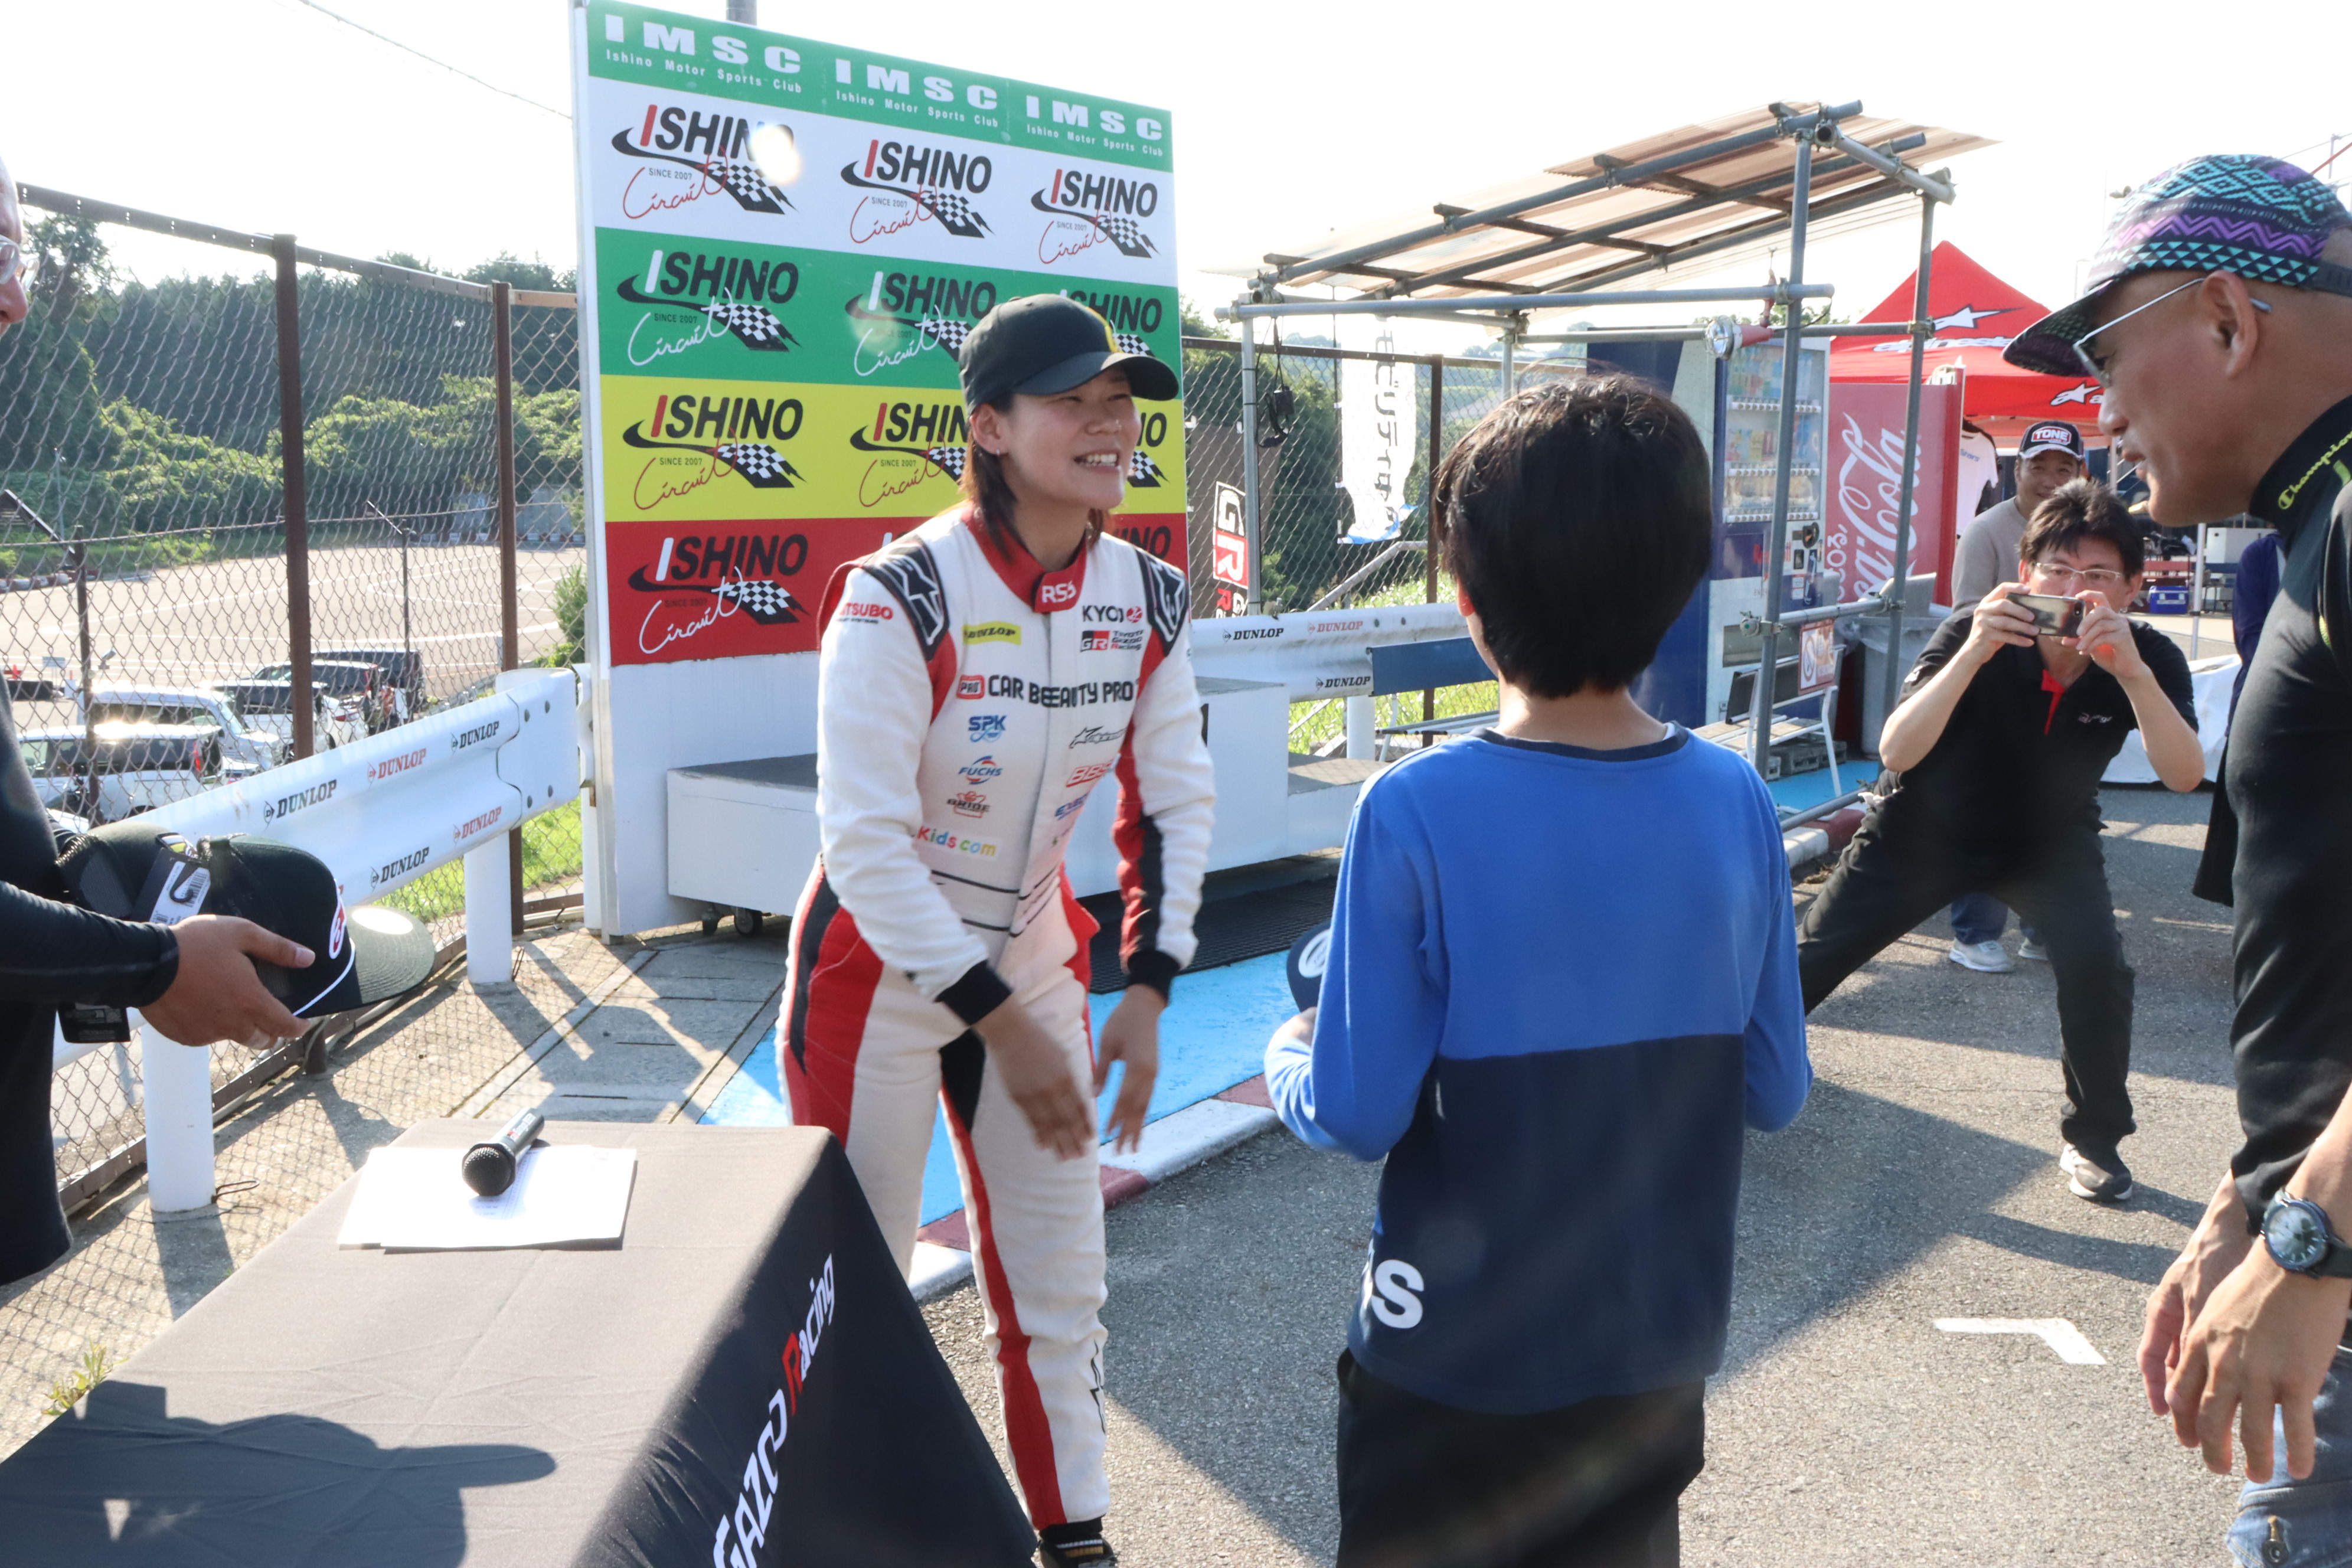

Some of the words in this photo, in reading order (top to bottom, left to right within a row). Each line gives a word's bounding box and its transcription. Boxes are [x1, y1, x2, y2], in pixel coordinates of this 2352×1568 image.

[606, 49, 652, 67] Ishino
[665, 60, 705, 76] Motor
[717, 68, 762, 86] Sports
[773, 79, 801, 93] Club
[837, 90, 874, 106] Ishino
[885, 99, 918, 113] Motor
[928, 106, 965, 122] Sports
[974, 115, 998, 128] Club
[1027, 124, 1059, 138] Ishino
[1067, 131, 1095, 145] Motor
[1103, 138, 1135, 152] Sports
[1142, 145, 1162, 156] Club
[623, 145, 728, 219] Circuit
[649, 168, 672, 178] SINCE
[675, 171, 692, 181] 2007
[864, 139, 992, 194] ISHINO
[850, 176, 937, 243] Circuit
[871, 198, 891, 207] SINCE
[893, 199, 908, 208] 2007
[1051, 169, 1158, 217] ISHINO
[1039, 201, 1112, 264] Circuit
[1056, 221, 1072, 230] SINCE
[1074, 223, 1087, 231] 2007
[645, 250, 799, 303] ISHINO
[868, 271, 997, 319] ISHINO
[628, 287, 733, 366] Circuit
[654, 313, 677, 323] SINCE
[680, 315, 698, 324] 2007
[854, 305, 943, 377] Circuit
[651, 395, 803, 440] ISHINO
[873, 403, 967, 443] ISHIN
[2036, 430, 2069, 442] TONE
[634, 427, 738, 510] Circuit
[859, 432, 946, 507] Circuit
[1217, 490, 1244, 581] GR
[655, 534, 808, 581] ISHINO
[639, 566, 743, 654] Circuit
[1317, 621, 1363, 632] DUNLOP
[968, 628, 1015, 638] DUNLOP
[1080, 634, 1110, 652] GR
[1233, 628, 1284, 640] DUNLOP
[988, 675, 1024, 700] CAR
[1103, 681, 1133, 703] PRO
[1325, 676, 1370, 688] DUNLOP
[459, 721, 499, 749] DUNLOP
[968, 715, 1007, 731] SPK
[378, 749, 427, 779] DUNLOP
[958, 767, 1003, 776] FUCHS
[276, 780, 337, 818] DUNLOP
[947, 799, 990, 812] BRIDE
[462, 806, 502, 838] DUNLOP
[917, 826, 957, 848] Kids
[960, 839, 996, 857] com
[381, 847, 430, 883] DUNLOP
[782, 1254, 834, 1416] Racing
